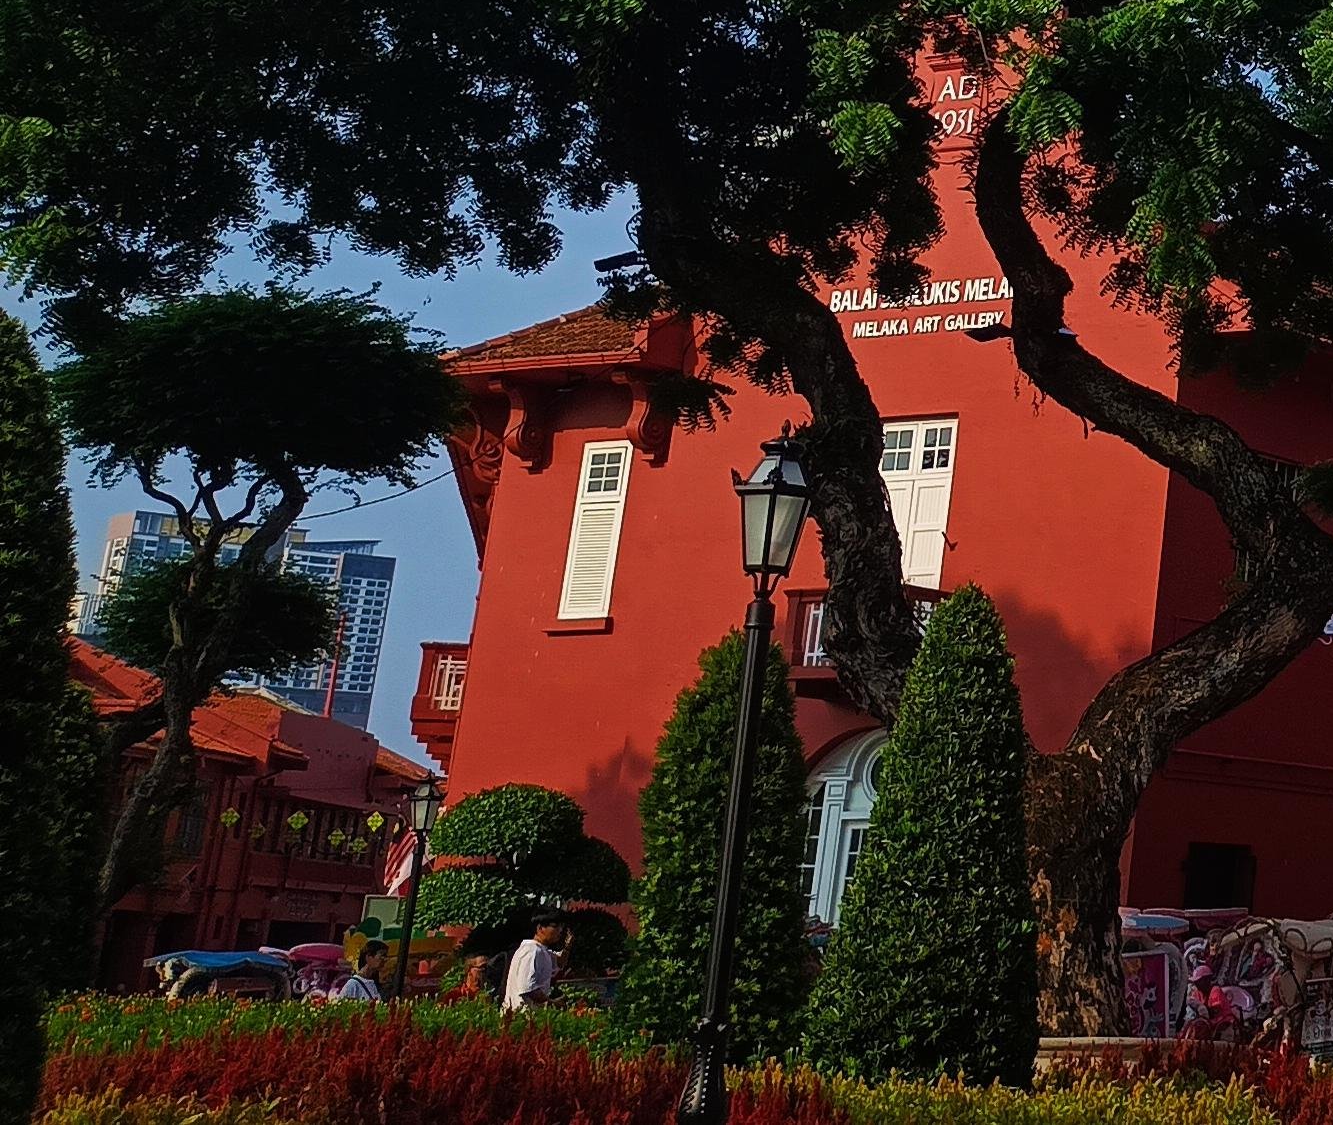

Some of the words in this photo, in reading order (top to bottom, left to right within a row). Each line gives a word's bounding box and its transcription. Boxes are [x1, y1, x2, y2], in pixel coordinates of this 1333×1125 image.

[938, 75, 977, 102] AD
[829, 288, 878, 312] BALAI
[963, 276, 1014, 302] MELA
[852, 318, 909, 338] MELAKA
[913, 315, 942, 334] ART
[944, 311, 1005, 331] GALLERY
